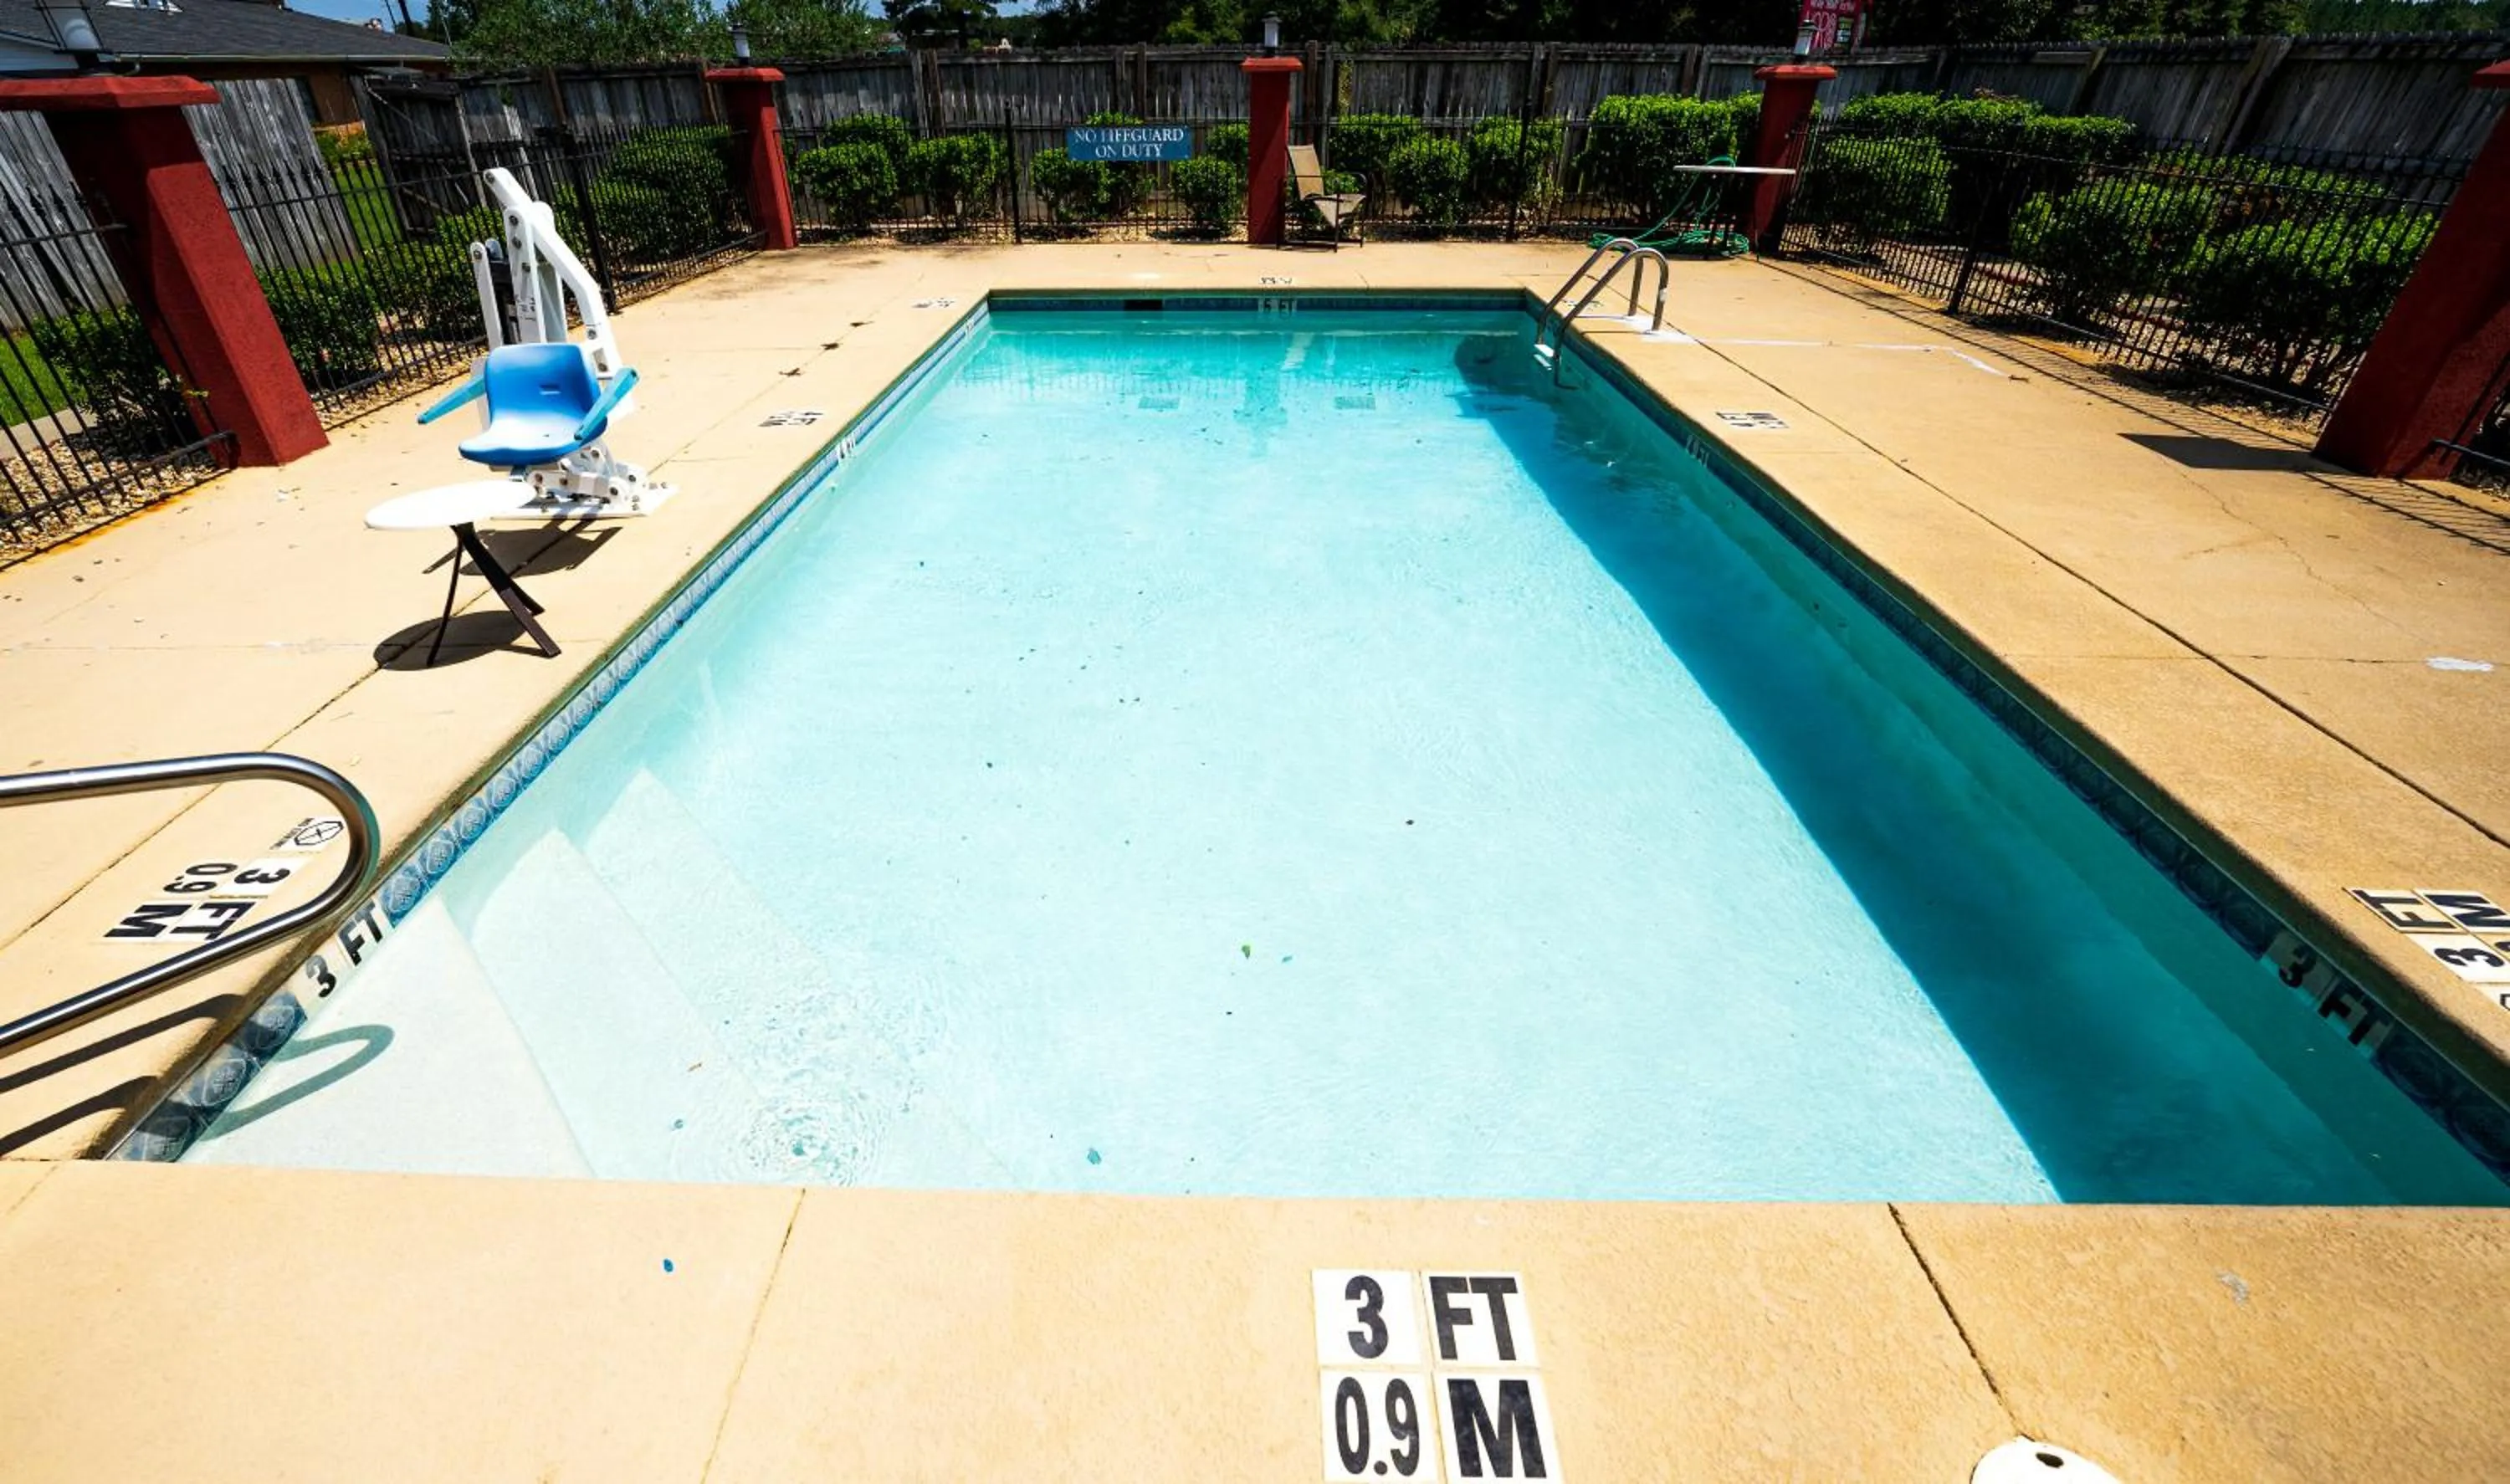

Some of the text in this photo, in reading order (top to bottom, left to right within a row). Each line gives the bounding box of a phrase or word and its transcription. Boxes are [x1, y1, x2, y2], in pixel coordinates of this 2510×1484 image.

[1074, 128, 1184, 143] NO LIFEGUARD
[1095, 143, 1163, 158] ON DUTY
[104, 862, 238, 938] 0.9 M
[168, 867, 291, 940] 3 FT
[2352, 889, 2505, 967] 3 FT
[306, 900, 382, 998] 3 FT
[2278, 944, 2393, 1046] 3 FT
[1345, 1275, 1518, 1361] 3 FT
[1334, 1376, 1547, 1478] 0.9 M
